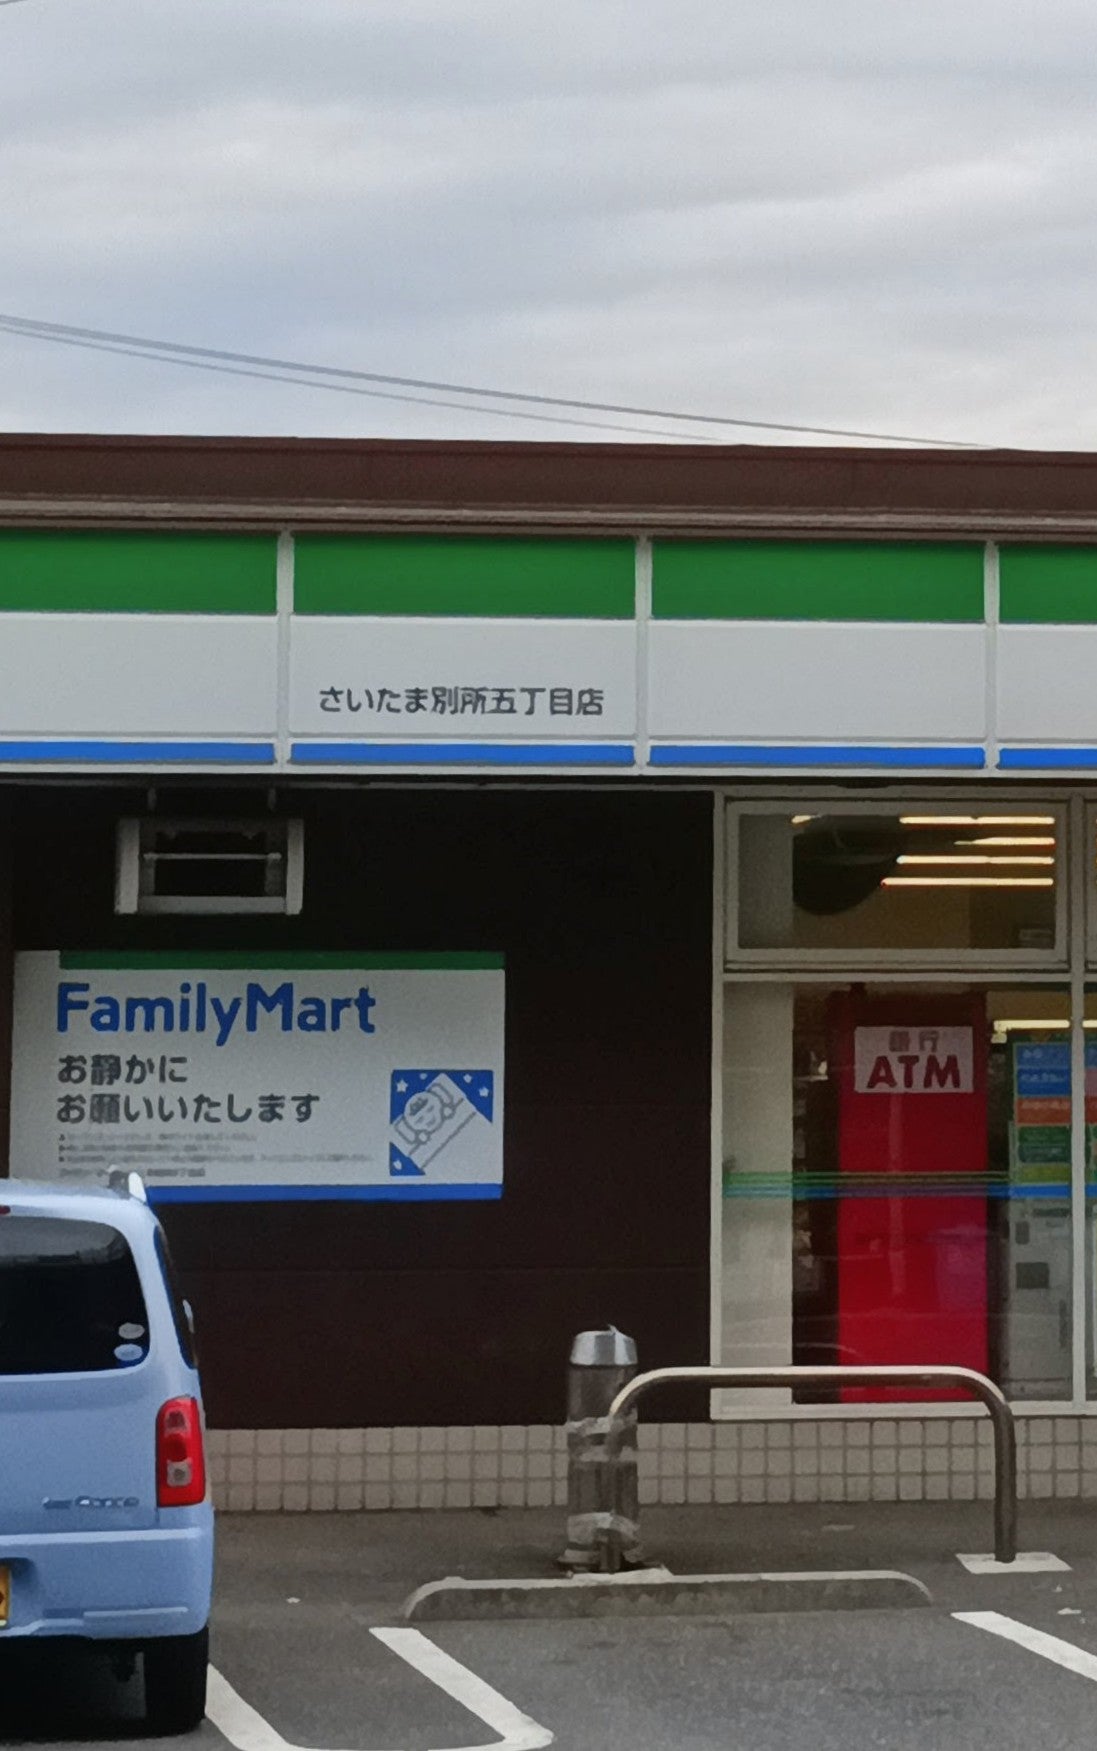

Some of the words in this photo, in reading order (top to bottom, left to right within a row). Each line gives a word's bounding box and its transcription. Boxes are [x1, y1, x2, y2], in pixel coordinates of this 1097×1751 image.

[319, 685, 604, 715] さいたま別所五丁目店
[57, 981, 376, 1046] FamilyMart
[57, 1054, 188, 1085] お静かに
[867, 1055, 960, 1088] ATM
[56, 1093, 320, 1123] お願いいたします
